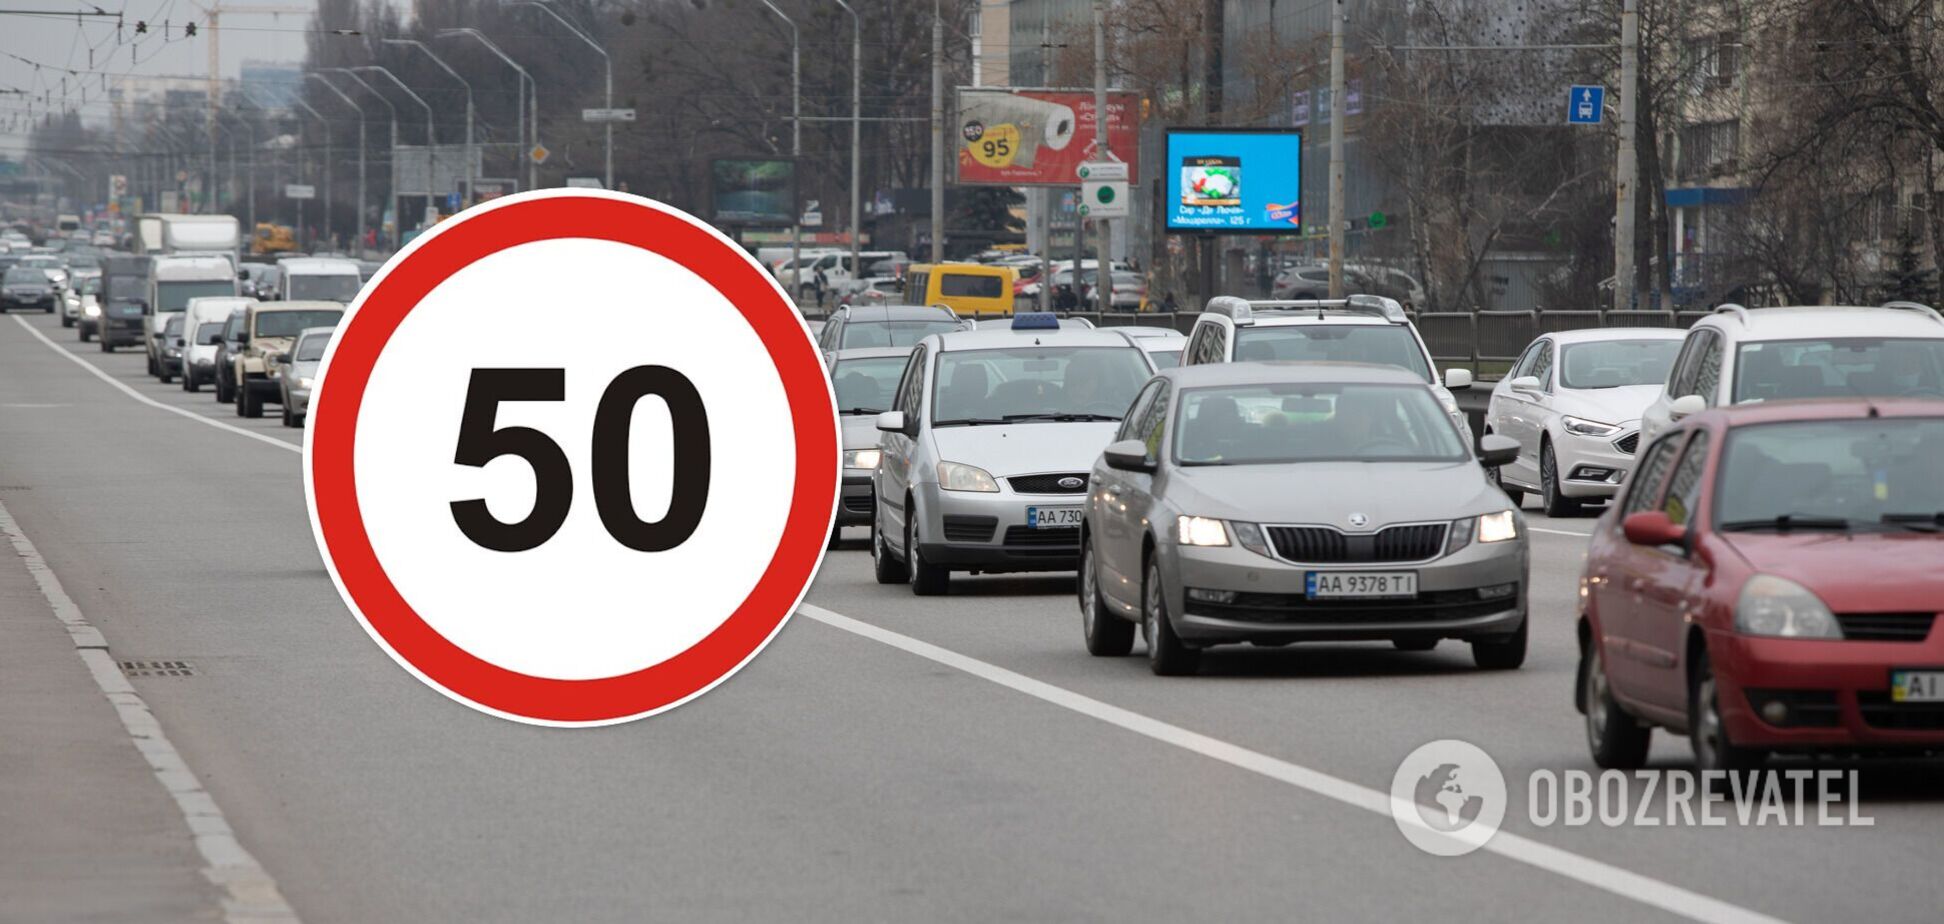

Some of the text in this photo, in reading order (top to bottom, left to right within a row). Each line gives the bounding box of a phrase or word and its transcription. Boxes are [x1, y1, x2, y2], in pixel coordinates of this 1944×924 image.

[983, 138, 1010, 158] 95
[1229, 216, 1244, 225] 125
[1038, 511, 1056, 524] AA
[1319, 576, 1342, 592] AA
[1347, 576, 1388, 592] 9378
